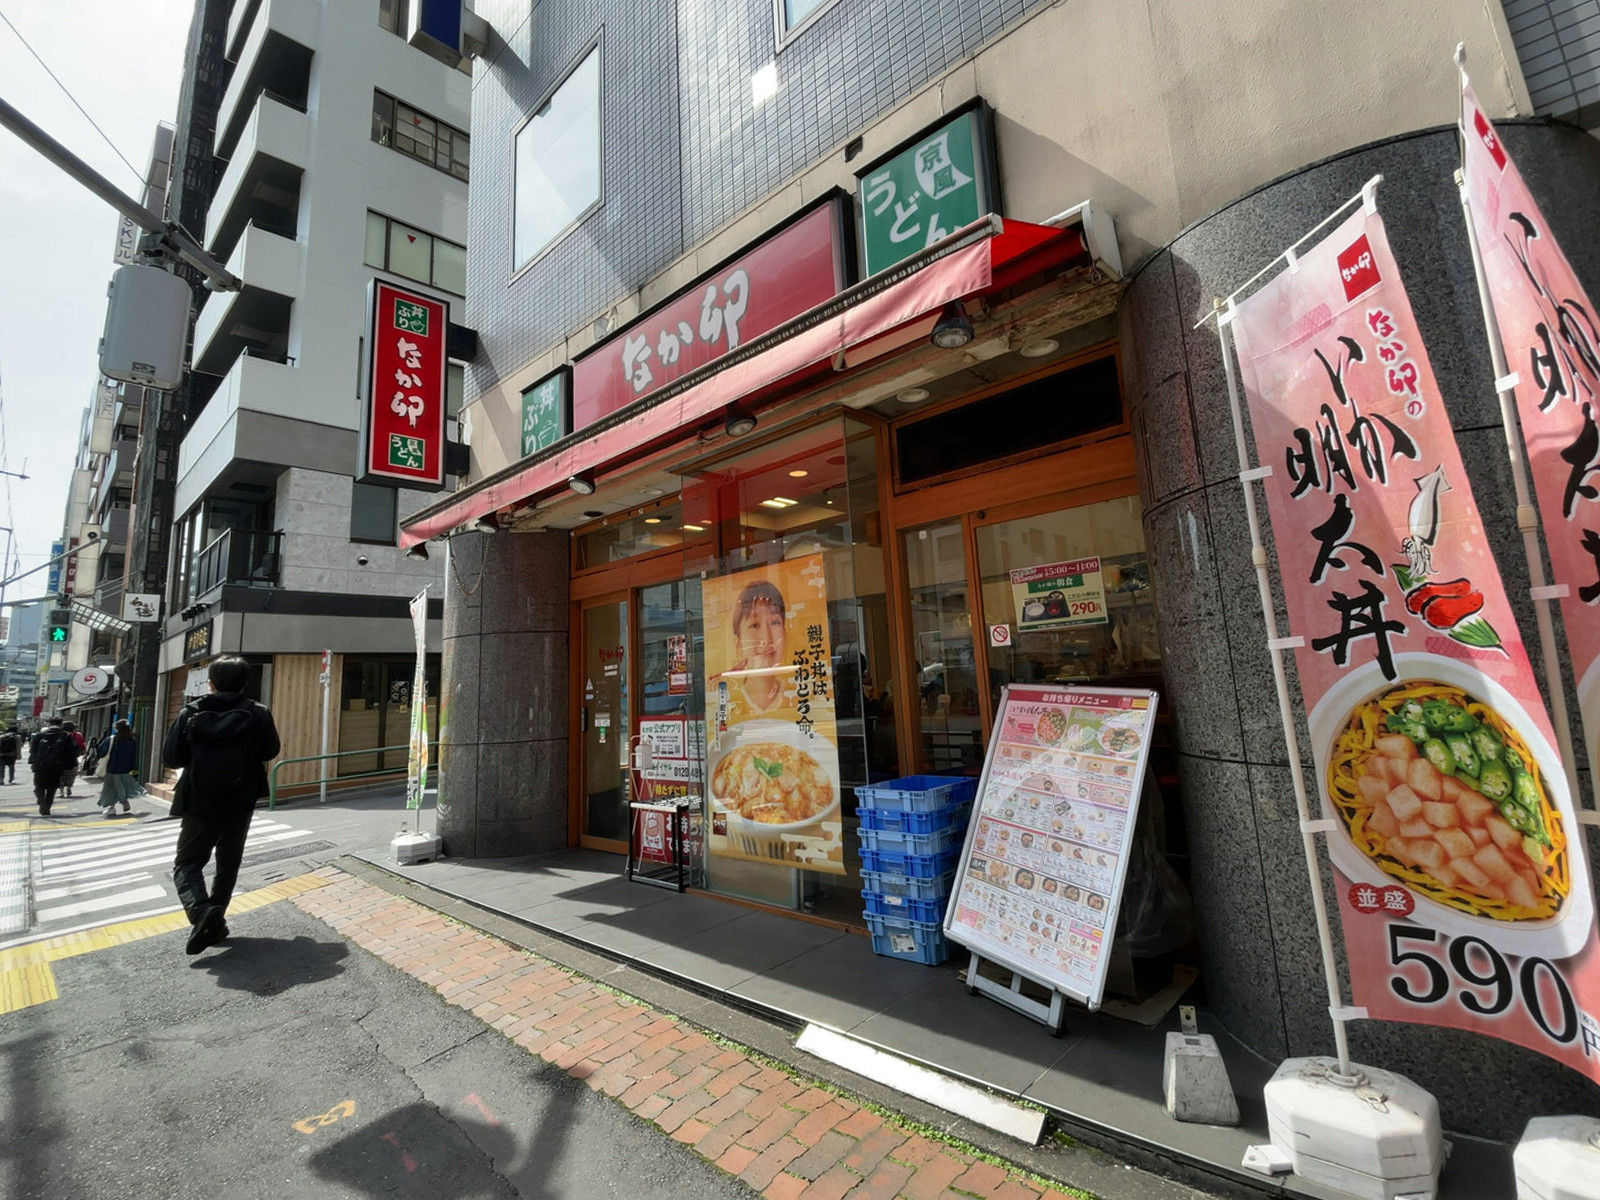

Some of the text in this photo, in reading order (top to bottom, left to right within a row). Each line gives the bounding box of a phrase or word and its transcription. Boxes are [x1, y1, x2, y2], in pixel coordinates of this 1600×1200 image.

[920, 141, 956, 197] 京風
[1342, 251, 1370, 282] なか卯
[622, 269, 749, 392] なか卯
[1368, 310, 1423, 416] なか卯の
[391, 337, 425, 429] なか卯
[792, 649, 814, 739] ふわとろ命。
[806, 623, 830, 702] 親子丼は、
[654, 723, 681, 733] 公式アプリ
[1042, 693, 1109, 705] お持ち帰りメニュー
[1356, 887, 1407, 911] 並盛
